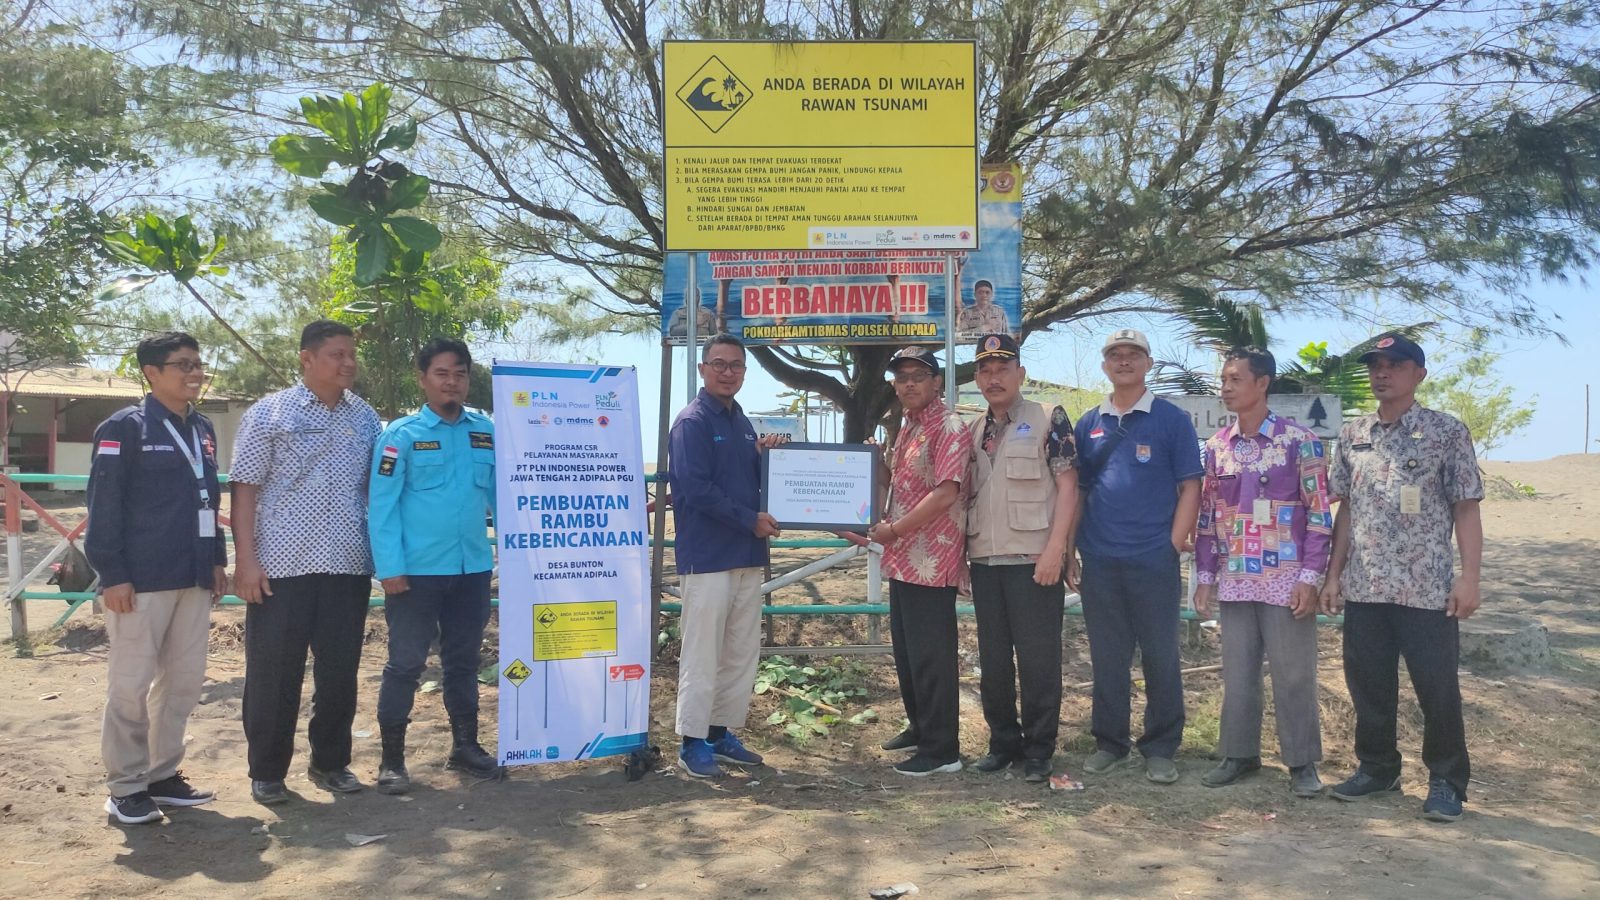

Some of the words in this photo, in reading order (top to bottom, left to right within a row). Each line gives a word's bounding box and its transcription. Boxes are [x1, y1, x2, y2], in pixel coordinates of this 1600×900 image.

[763, 77, 805, 91] ANDA
[813, 77, 871, 91] BERADA
[878, 77, 894, 91] DI
[901, 77, 965, 91] WILAYAH
[801, 98, 856, 112] RAWAN
[864, 98, 928, 112] TSUNAMI
[714, 266, 752, 278] JANGAN
[755, 264, 794, 278] SAMPAI
[798, 262, 842, 276] MENJADI
[845, 262, 888, 274] KORBAN
[891, 261, 957, 274] BERIKUTN
[744, 285, 892, 315] BERBAHAYA
[900, 285, 927, 312] !!!
[744, 324, 848, 338] POKDARKAMTIBMAS
[851, 324, 890, 337] POLSEK
[892, 323, 936, 336] ADIPALA
[532, 392, 558, 400] PLN
[518, 495, 629, 510] PEMBUATAN
[542, 513, 608, 528] RAMBU
[504, 531, 642, 549] KEBENCANAAN
[534, 572, 582, 580] KECAMATAN
[584, 570, 618, 578] ADIPALA
